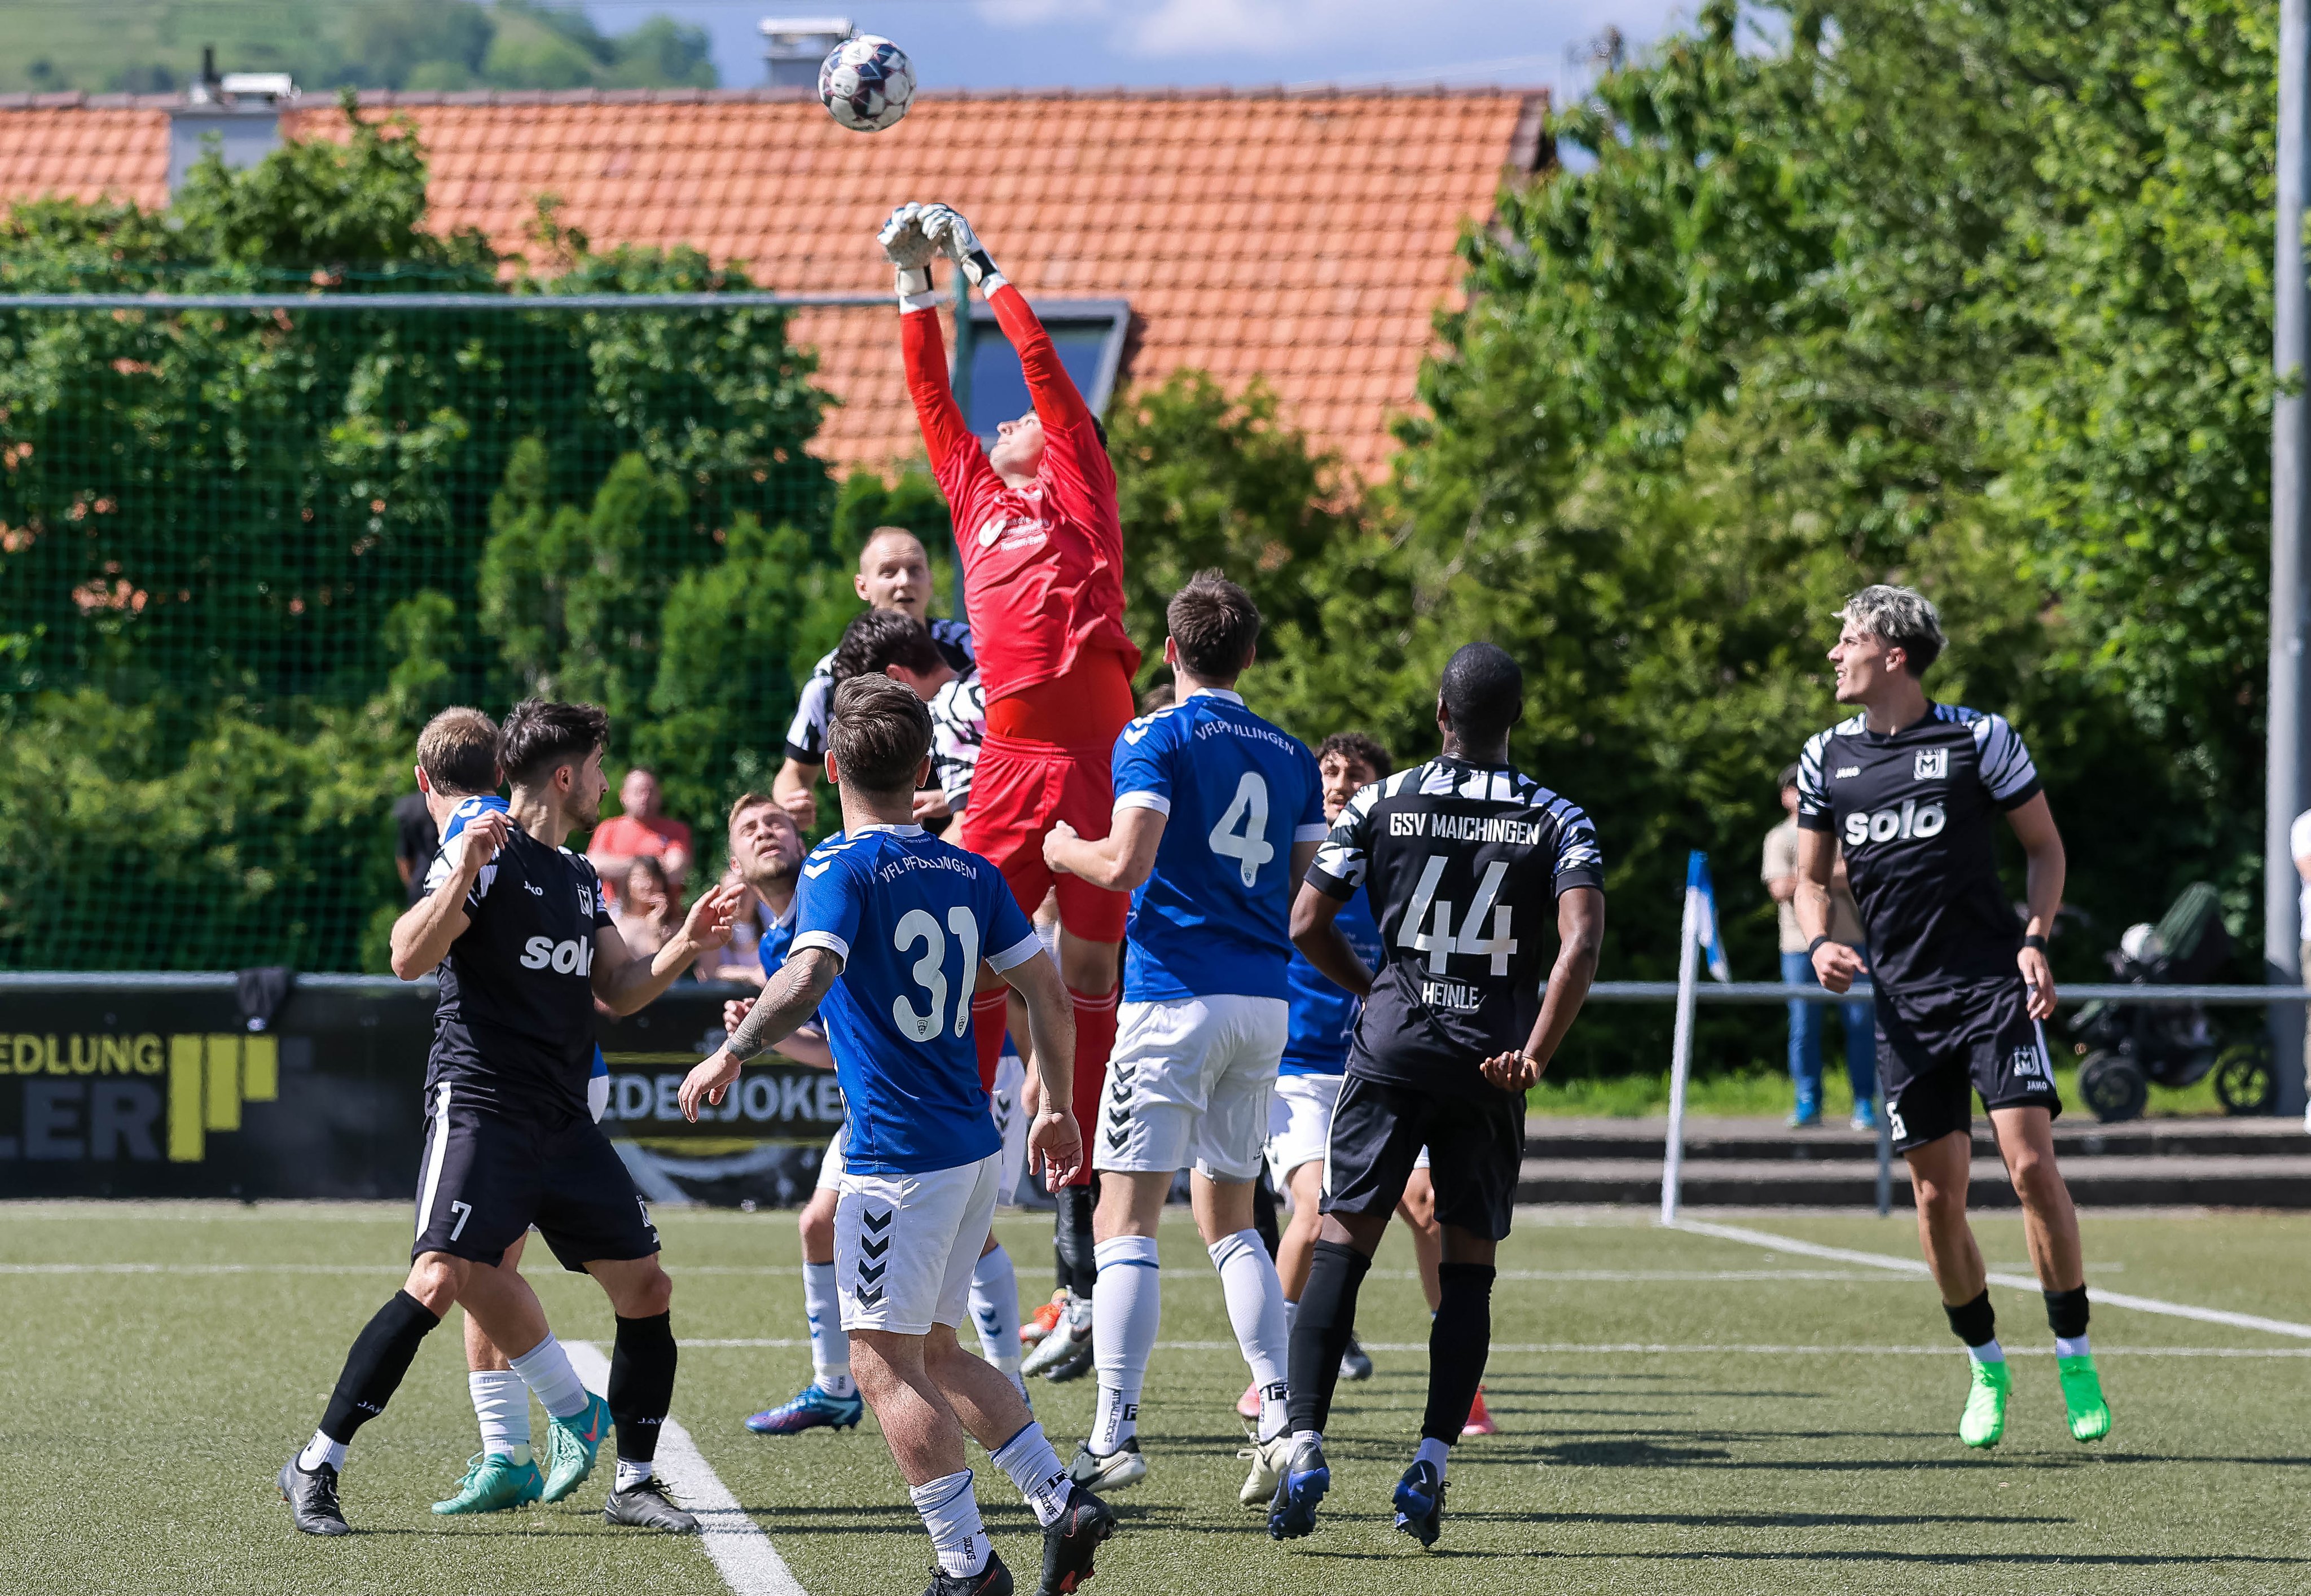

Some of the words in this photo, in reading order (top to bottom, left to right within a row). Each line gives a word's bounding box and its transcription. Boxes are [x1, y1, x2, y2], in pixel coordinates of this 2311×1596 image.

[1195, 722, 1220, 740] VFL
[1209, 771, 1274, 888] 4
[1390, 812, 1427, 837] GSV
[1431, 814, 1540, 846] MAICHINGEN
[1846, 799, 1946, 846] solo
[524, 881, 543, 896] JAKO
[879, 861, 904, 883] VFL
[1398, 855, 1518, 976] 44
[520, 935, 594, 978] sol
[893, 907, 979, 1042] 31
[1422, 982, 1480, 1009] HEINLE
[0, 1081, 160, 1160] ER
[450, 1201, 472, 1241] 7
